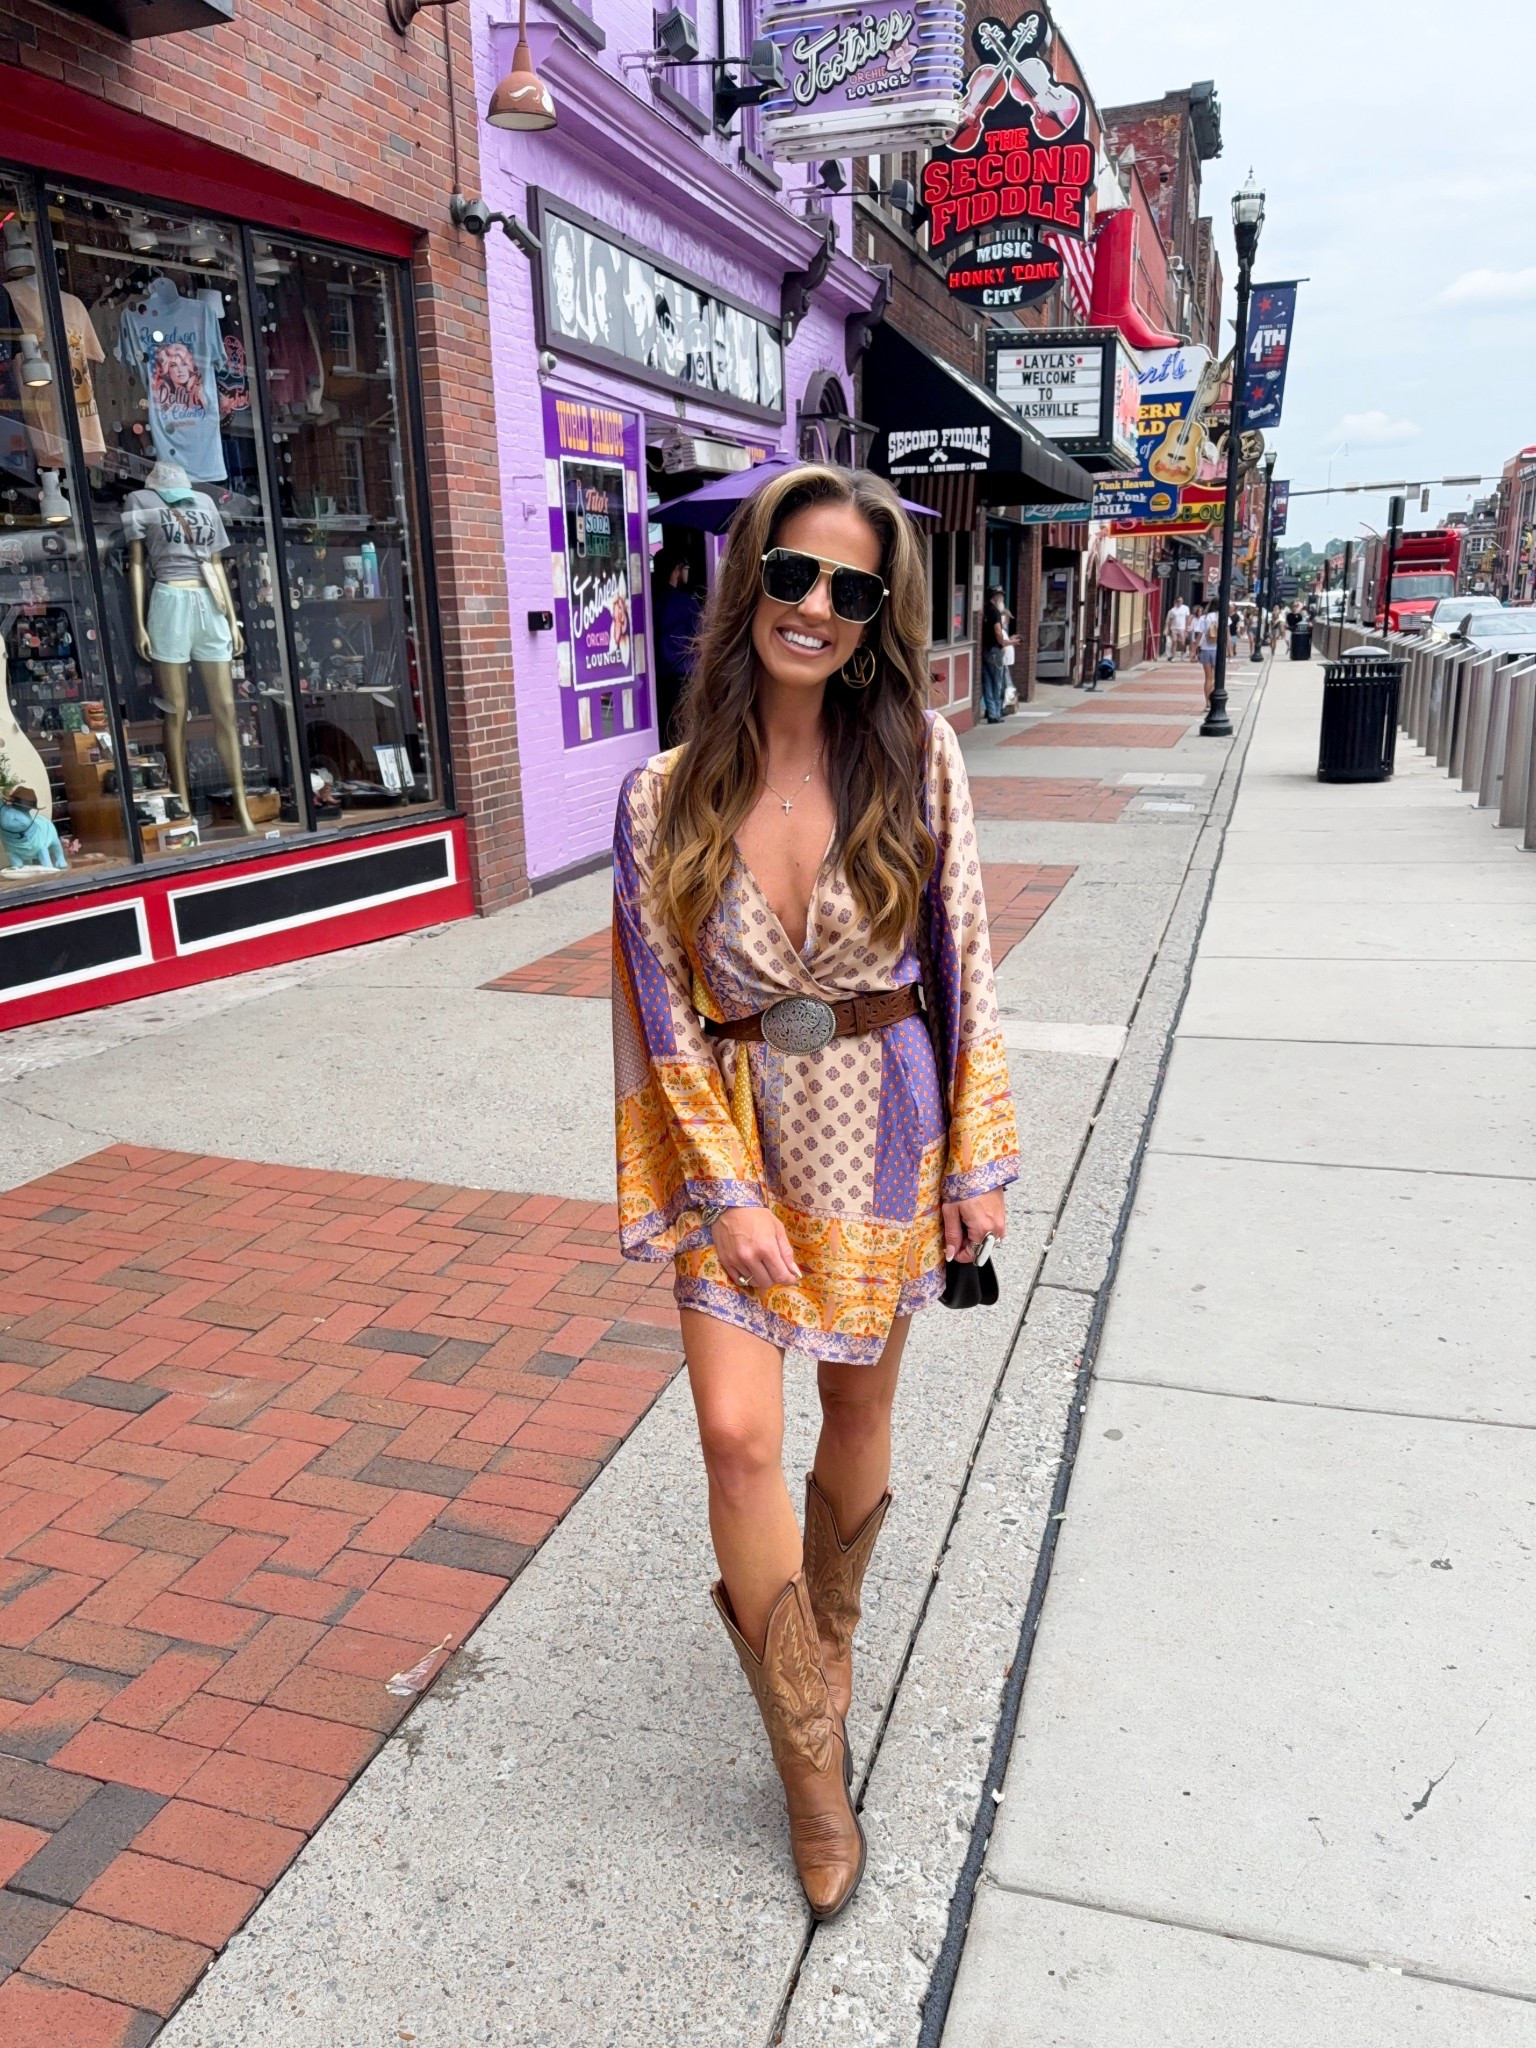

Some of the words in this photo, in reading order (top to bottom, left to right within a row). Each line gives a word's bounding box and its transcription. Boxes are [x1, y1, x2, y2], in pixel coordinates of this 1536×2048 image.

[793, 9, 913, 104] Tootsies
[849, 67, 888, 84] ORCHID
[847, 74, 911, 99] LOUNGE
[985, 128, 1029, 153] THE
[925, 144, 1091, 203] SECOND
[931, 185, 1081, 245] FIDDLE
[976, 242, 1032, 263] MUSIC
[949, 268, 1005, 288] HONKY
[1012, 262, 1059, 281] TONK
[983, 286, 1023, 305] CITY
[1250, 329, 1287, 362] 4TH
[1024, 354, 1076, 368] LAYLA'S
[1022, 371, 1076, 385] WELCOME
[160, 385, 191, 410] Dolly
[1038, 388, 1053, 401] TO
[1016, 403, 1079, 417] NASHVILLE
[556, 400, 589, 451] WORLD
[590, 407, 625, 457] FAMOUS
[1138, 420, 1166, 436] LD
[888, 430, 939, 464] SECOND
[941, 426, 990, 458] FIDDLE
[1140, 440, 1155, 459] of
[890, 466, 916, 475] ROOFTOP
[933, 464, 946, 473] LIVE
[946, 463, 966, 472] MUSIC
[970, 462, 988, 471] PIZZA
[1099, 480, 1121, 490] Tonk
[1122, 480, 1155, 489] Heaven
[586, 487, 609, 514] Tito's
[1116, 492, 1147, 503] Tonk
[159, 509, 214, 528] NSH
[586, 513, 611, 535] SODA
[586, 533, 612, 557] LIME
[573, 572, 619, 639] Tootsies
[586, 630, 610, 648] ORCHID
[586, 650, 623, 669] LOUNGE
